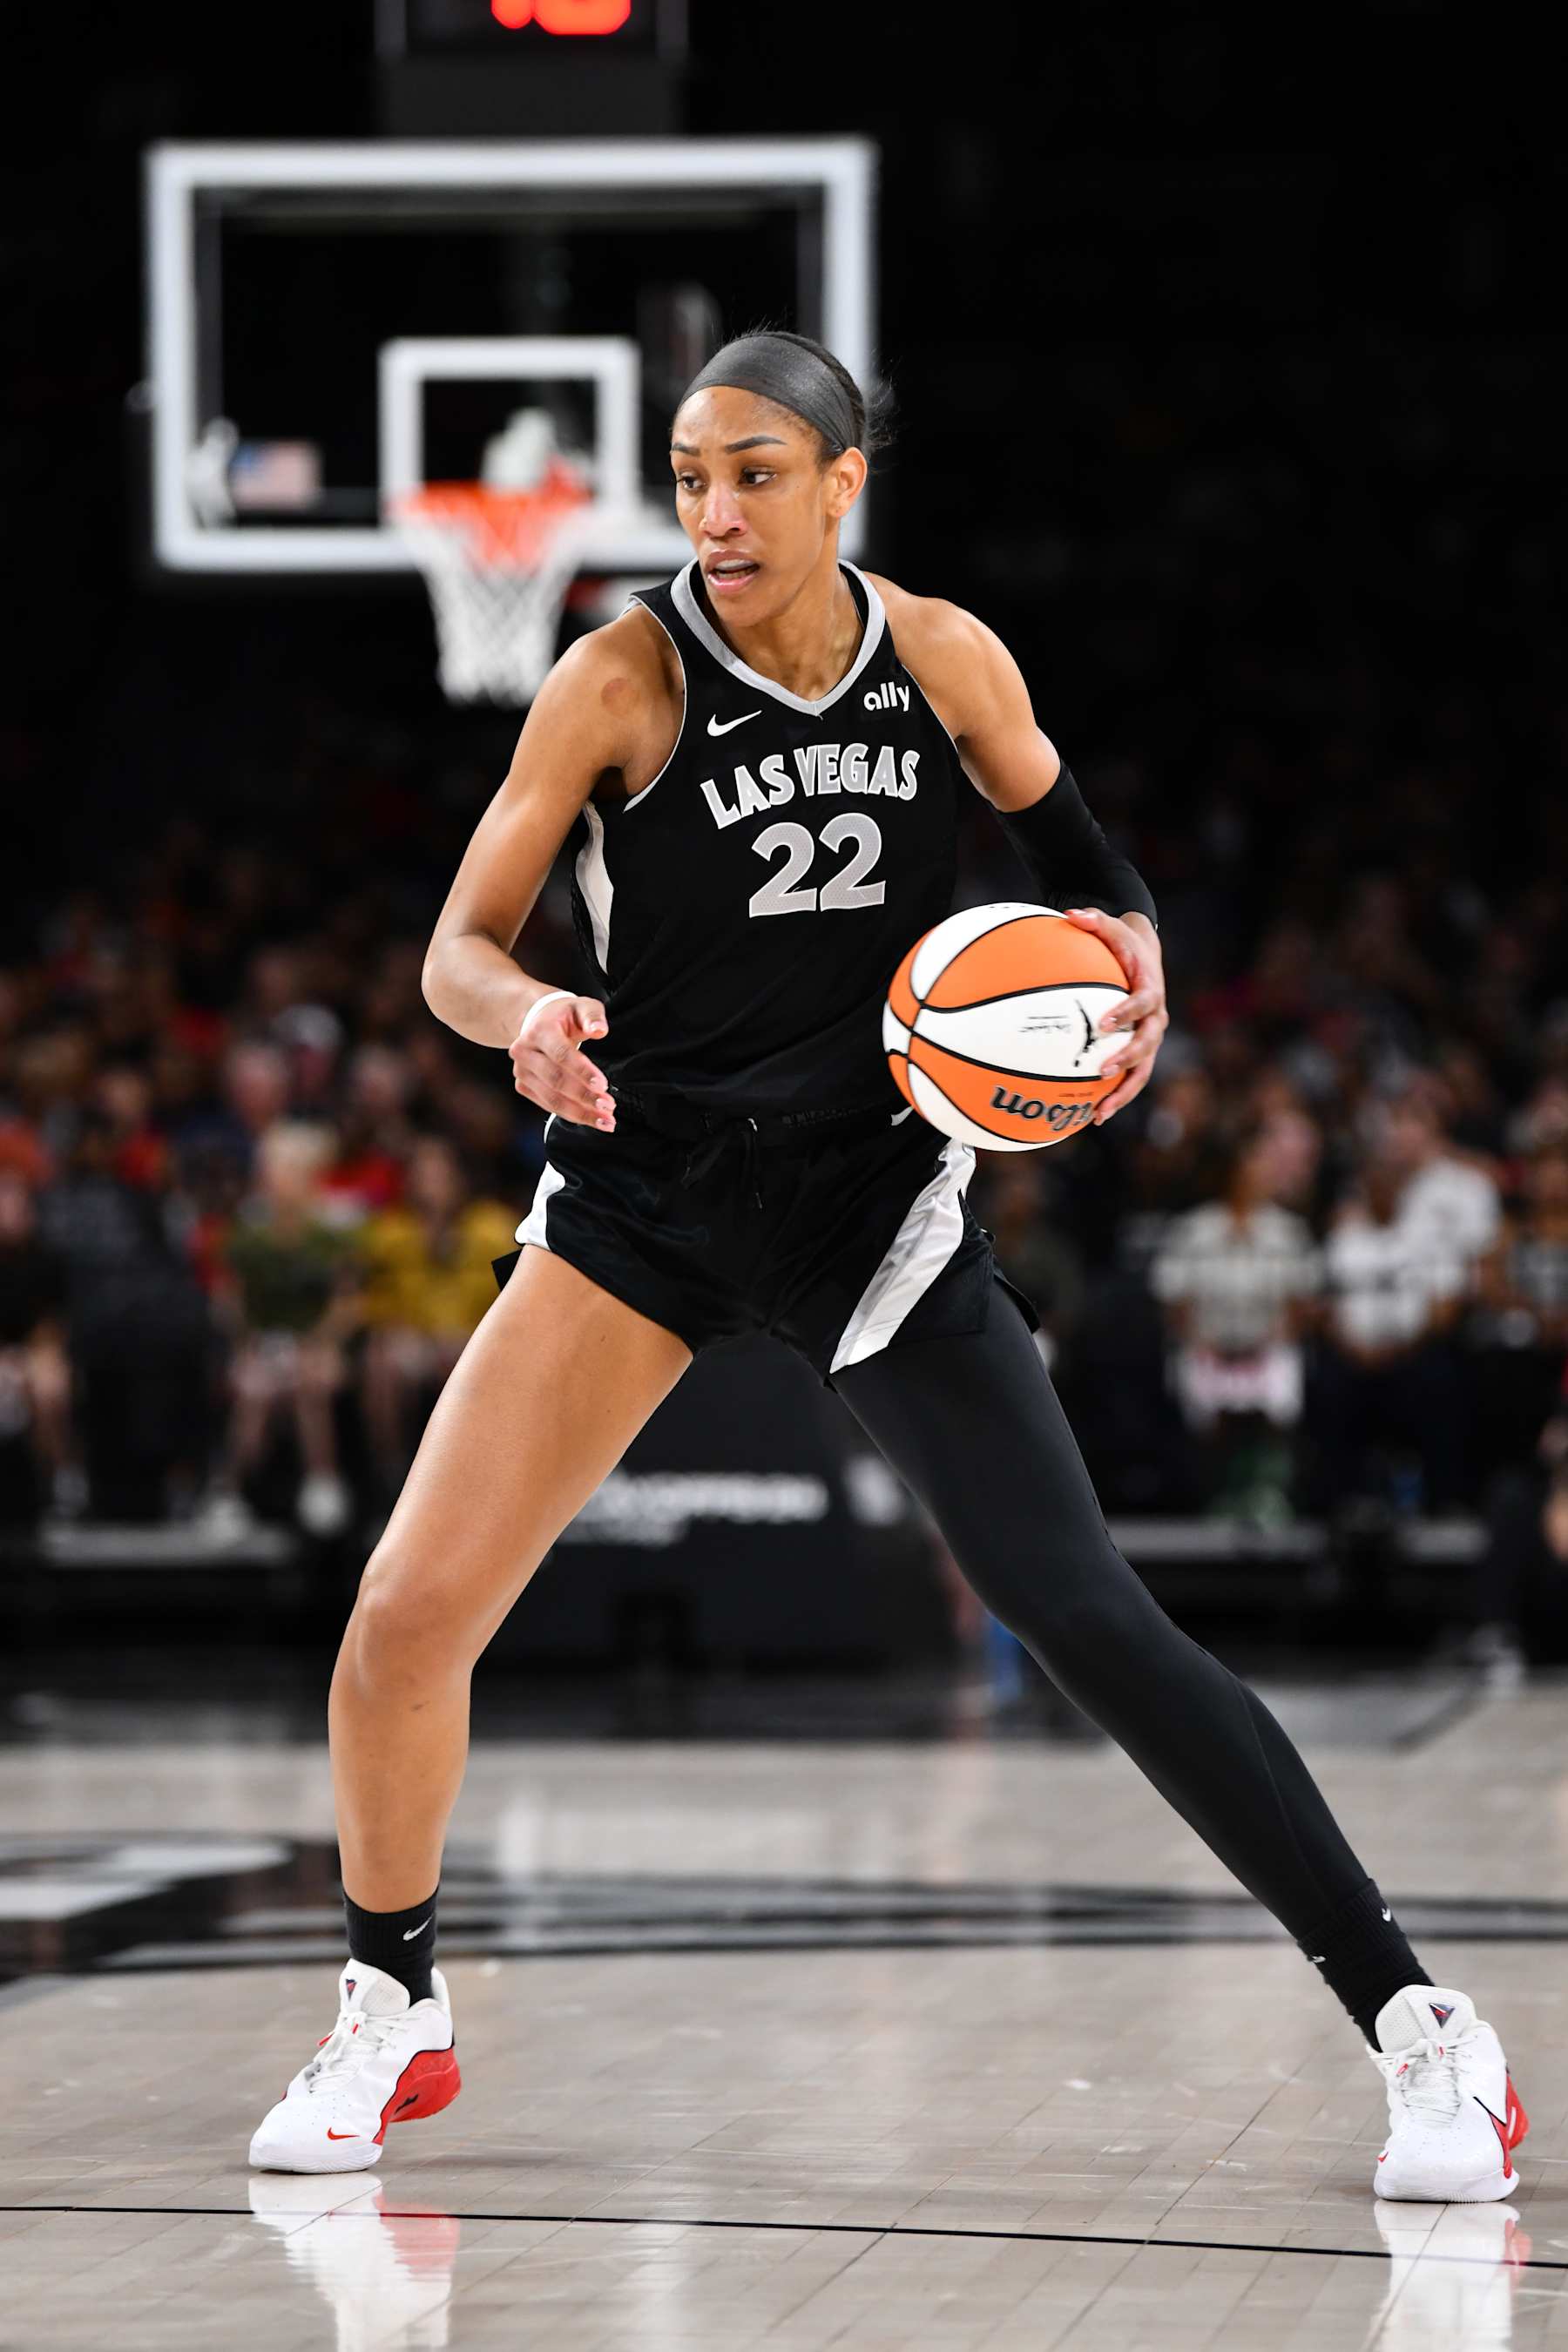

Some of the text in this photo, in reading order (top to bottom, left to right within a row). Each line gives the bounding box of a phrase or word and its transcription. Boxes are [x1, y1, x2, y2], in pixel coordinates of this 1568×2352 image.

[863, 681, 909, 712] ally
[700, 743, 920, 829] LAS VEGAS
[749, 812, 886, 918] 22
